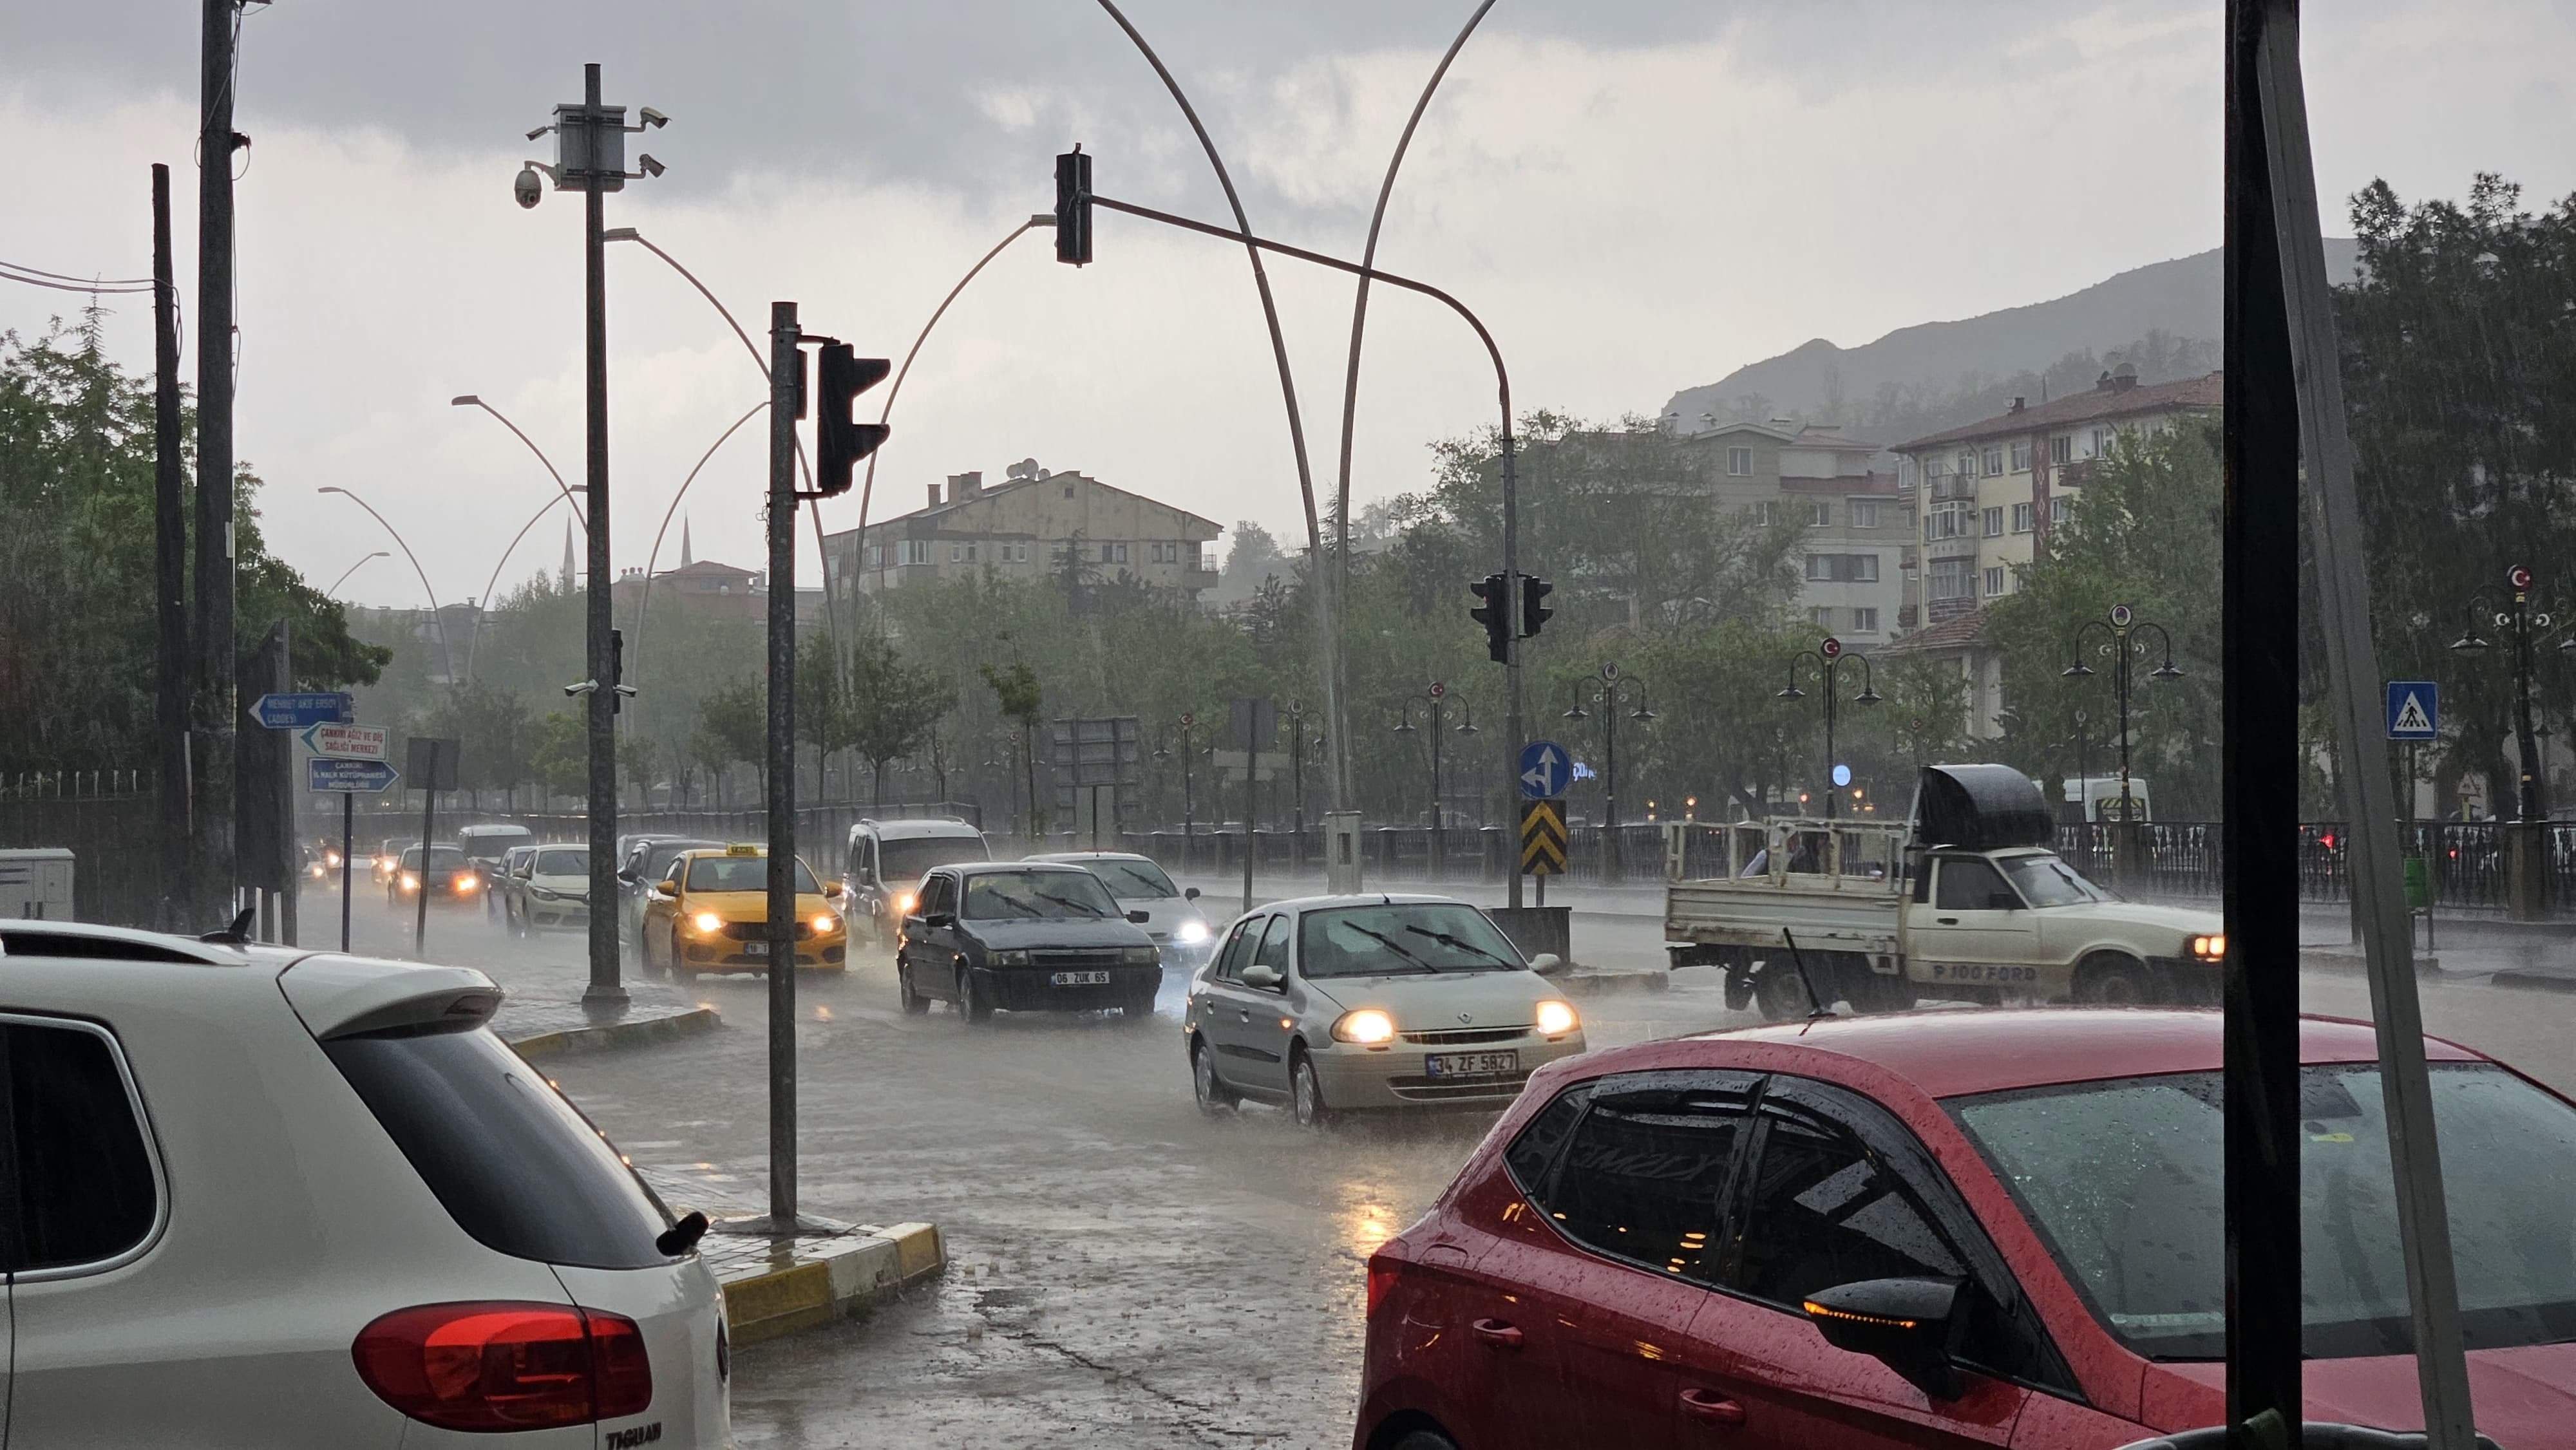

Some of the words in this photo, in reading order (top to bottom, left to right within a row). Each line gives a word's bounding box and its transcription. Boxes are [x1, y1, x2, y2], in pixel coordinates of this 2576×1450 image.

[363, 731, 372, 741] VE
[1057, 974, 1068, 984] 06
[1074, 973, 1090, 983] ZUK
[1095, 972, 1106, 983] 65
[1934, 965, 1944, 979] P
[1987, 966, 2037, 981] FORD
[1435, 1057, 1453, 1074] 34
[1458, 1056, 1475, 1072] ZF
[1481, 1053, 1514, 1071] 5827
[606, 1422, 661, 1450] TIGUAN
